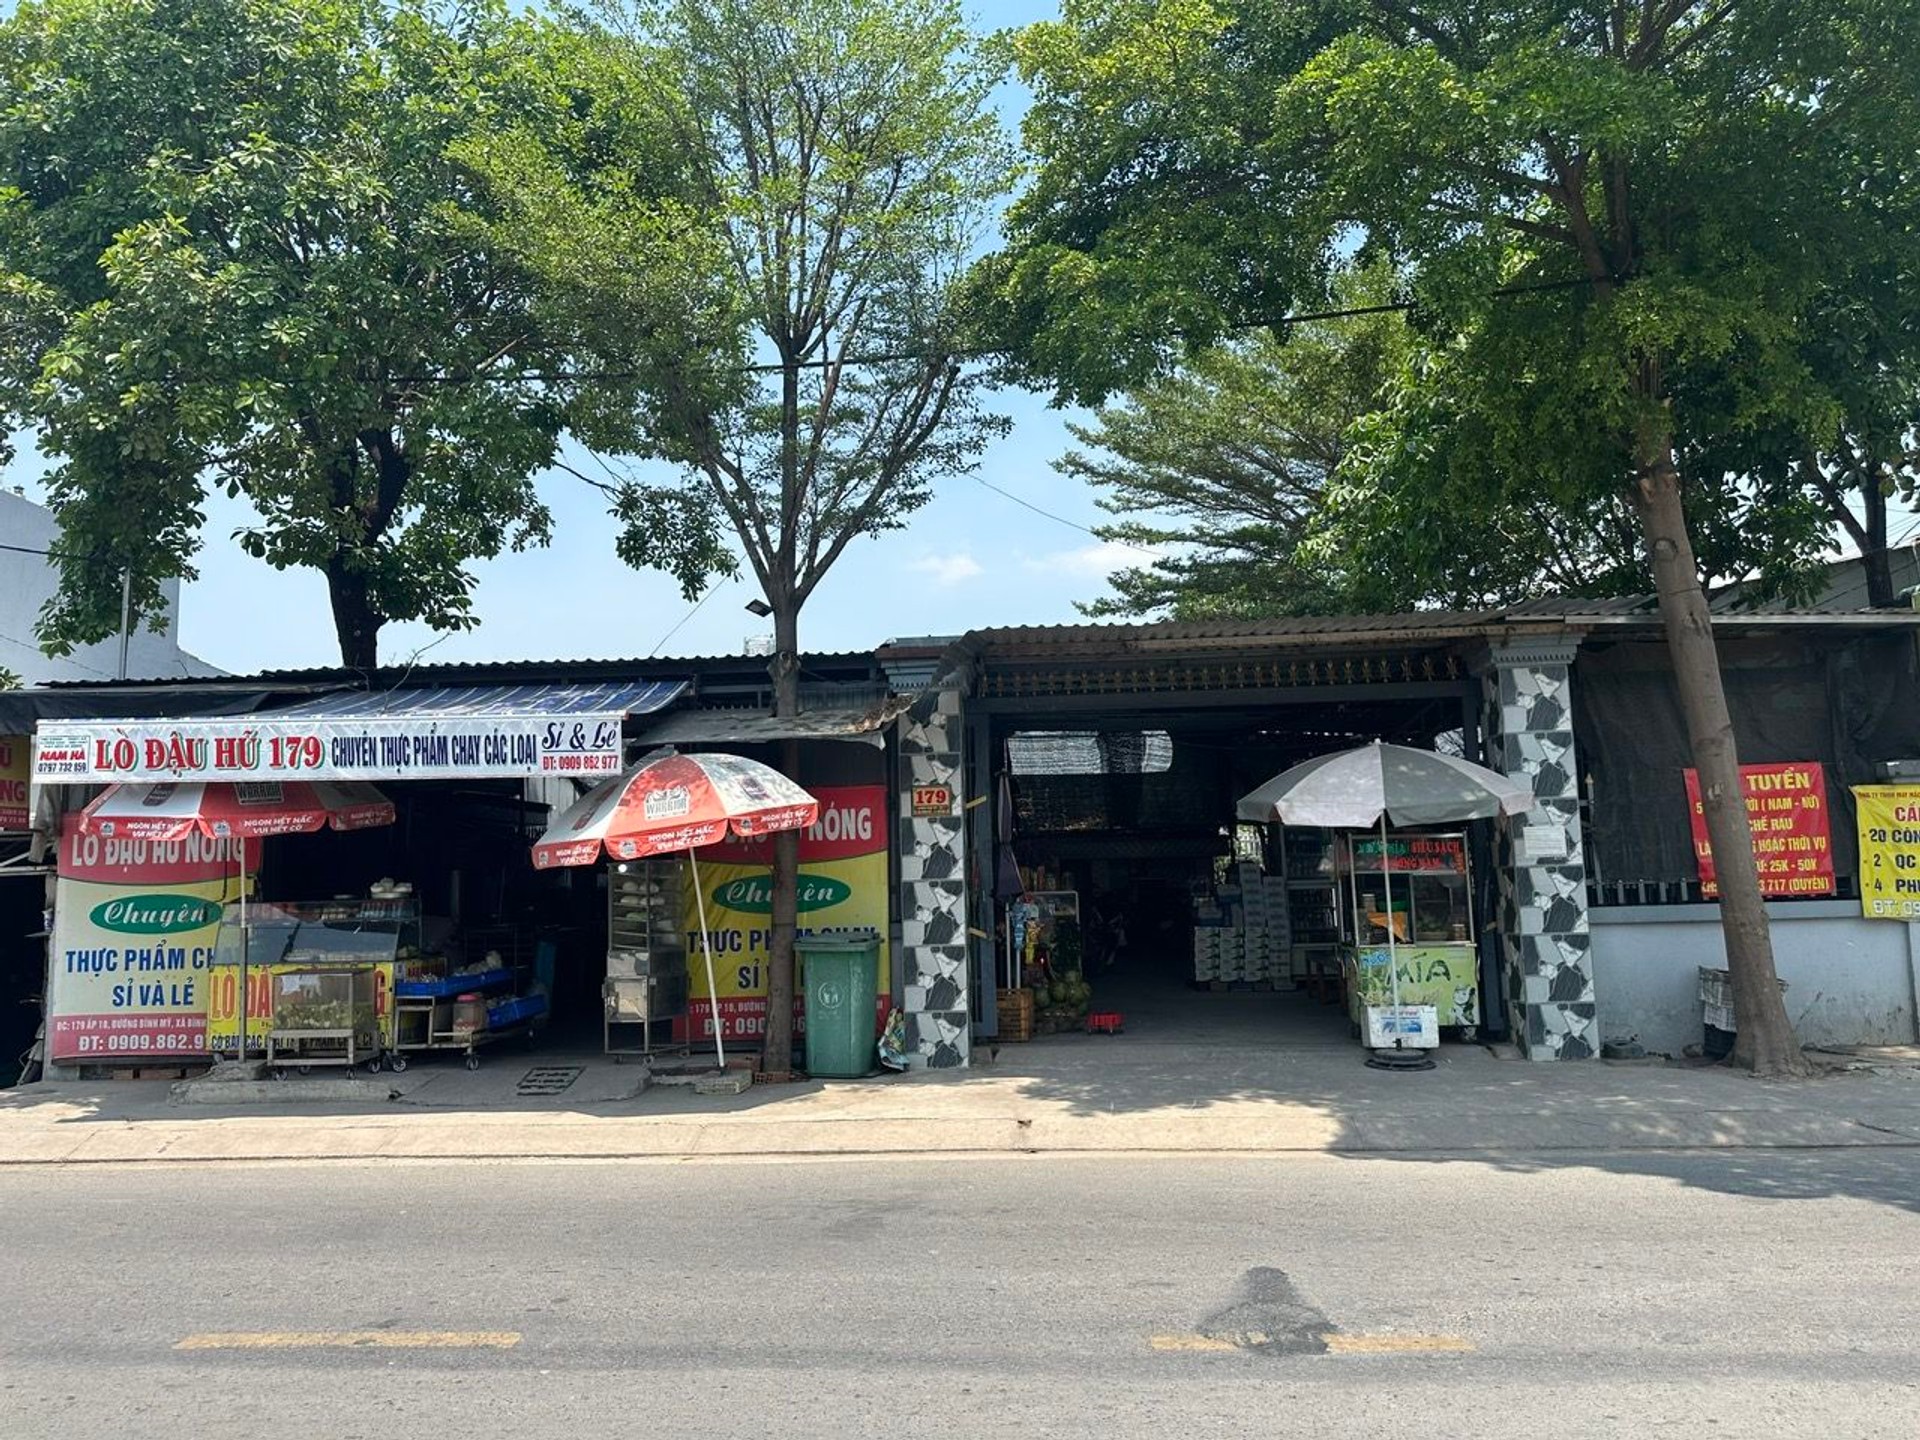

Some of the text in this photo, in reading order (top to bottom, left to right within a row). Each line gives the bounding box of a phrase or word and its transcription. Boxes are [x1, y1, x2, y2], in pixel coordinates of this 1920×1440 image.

[331, 722, 537, 774] CHUYÊN THỰC PHẨM CHAY CÁC LOẠI
[569, 722, 586, 751] &
[94, 728, 138, 771] LÒ
[145, 731, 208, 777] ĐẬU
[269, 736, 325, 770] 179
[559, 755, 581, 770] 0909
[602, 755, 619, 769] 977
[1746, 766, 1810, 791] TUYỂN
[916, 789, 946, 804] 179
[1768, 797, 1792, 811] NAM
[808, 802, 873, 842] NÓNG
[1869, 829, 1887, 843] 20
[1873, 853, 1916, 870] 2 QC
[726, 877, 835, 904] Chên
[1767, 878, 1786, 892] 717
[1873, 878, 1883, 893] 4
[104, 900, 207, 927] Chuyên
[66, 948, 118, 977] THỰC
[125, 939, 185, 971] PHẨM
[738, 958, 759, 989] SỈ
[113, 976, 194, 1007] SỈ VÀ LẺ
[108, 1034, 204, 1050] 0909.862.9
